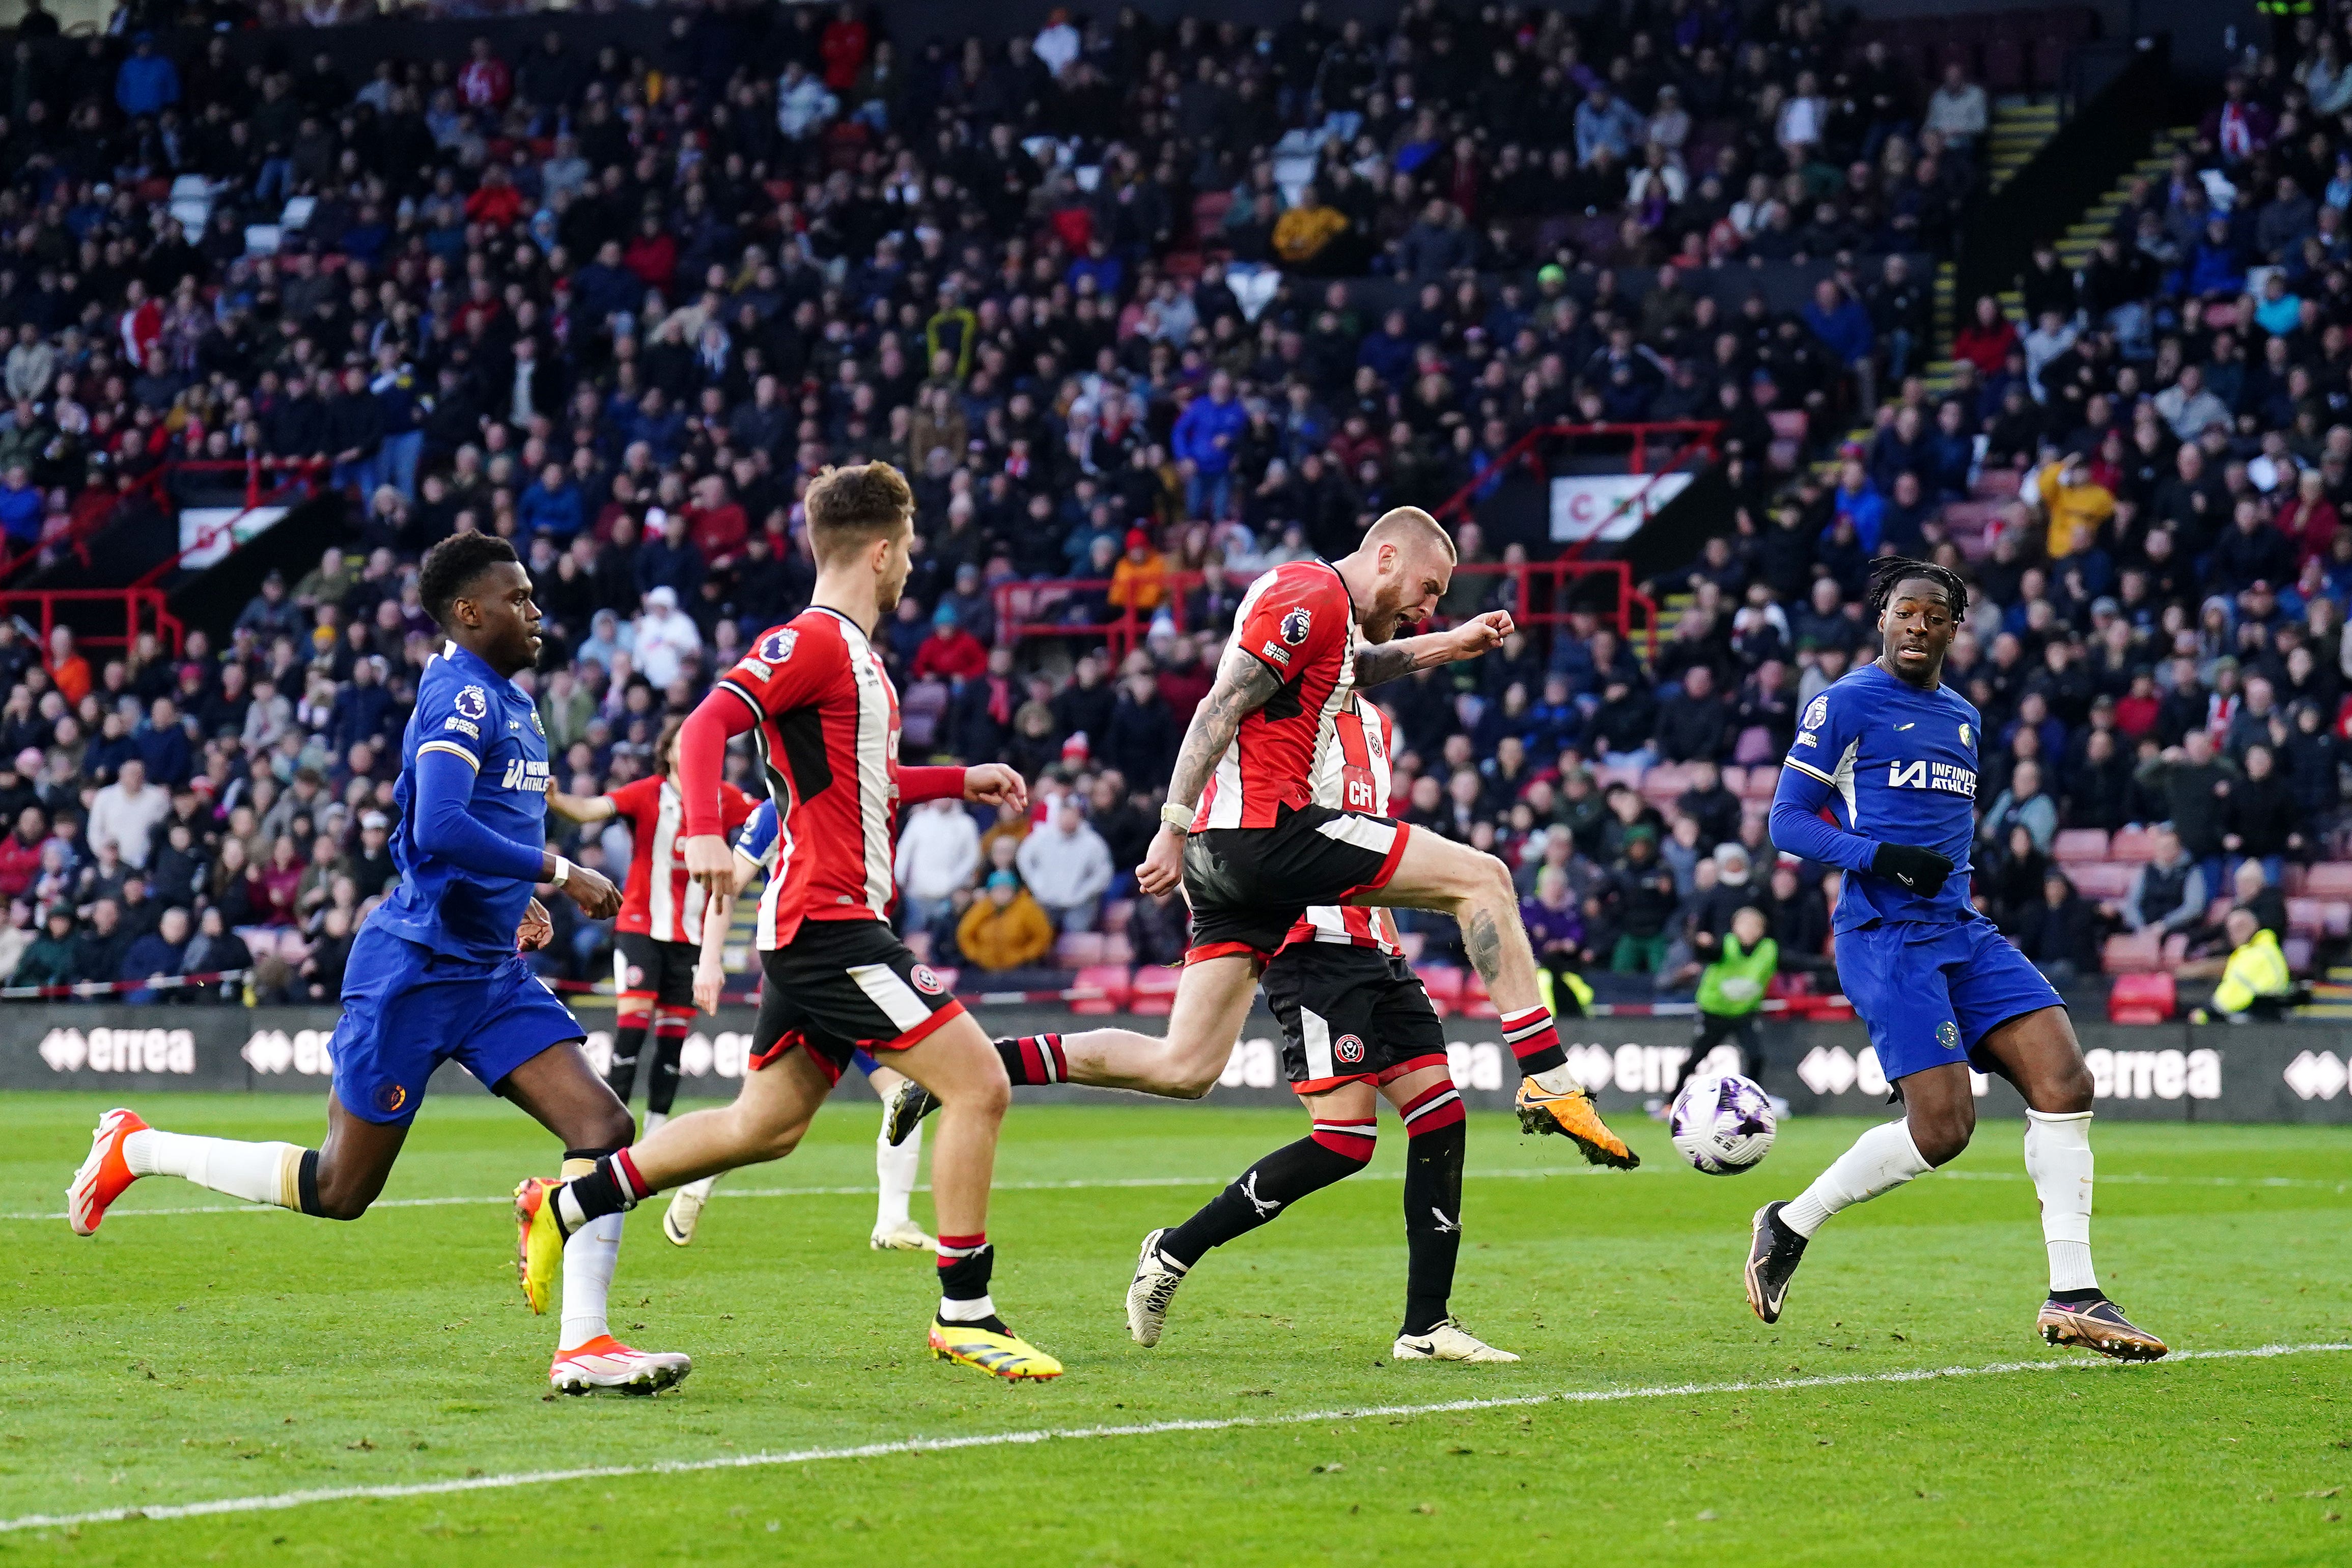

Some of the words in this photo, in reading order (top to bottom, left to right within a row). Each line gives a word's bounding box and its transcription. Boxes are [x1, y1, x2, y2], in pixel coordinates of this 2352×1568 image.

[1262, 648, 1275, 657] for
[1265, 640, 1277, 652] No
[446, 716, 459, 724] No
[459, 719, 479, 734] room
[1931, 762, 1977, 785] INFINIT
[521, 776, 550, 792] ATHLE
[1931, 777, 1977, 796] ATHLET
[1349, 780, 1373, 808] CFI
[88, 1027, 196, 1074] errea
[2085, 1047, 2222, 1099] errea
